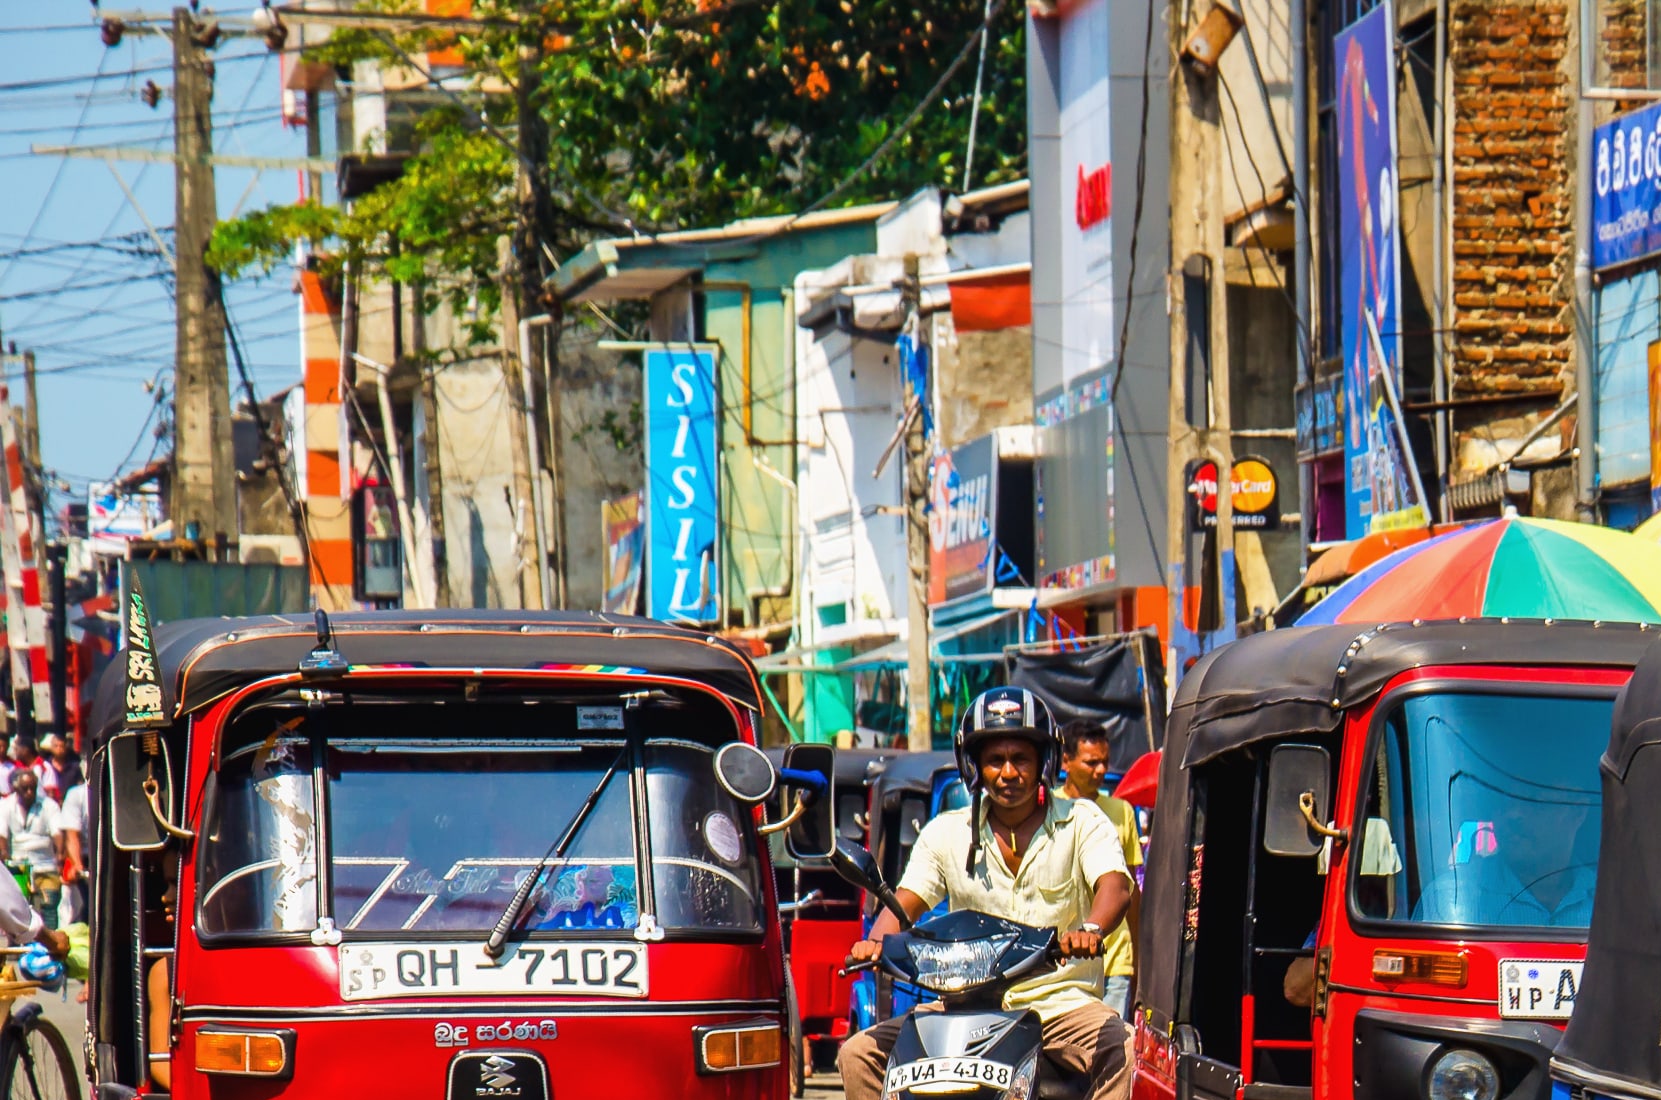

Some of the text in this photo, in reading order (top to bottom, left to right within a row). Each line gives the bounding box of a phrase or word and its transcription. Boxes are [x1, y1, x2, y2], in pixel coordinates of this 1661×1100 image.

[1197, 479, 1272, 494] MaerCard
[1204, 514, 1267, 526] PRERRED
[396, 949, 459, 987] QH
[517, 948, 639, 988] 7102
[1553, 968, 1577, 1010] A
[434, 1019, 558, 1048] බුදු සරණයි
[970, 1026, 989, 1038] TVS
[953, 1061, 1009, 1085] 4188
